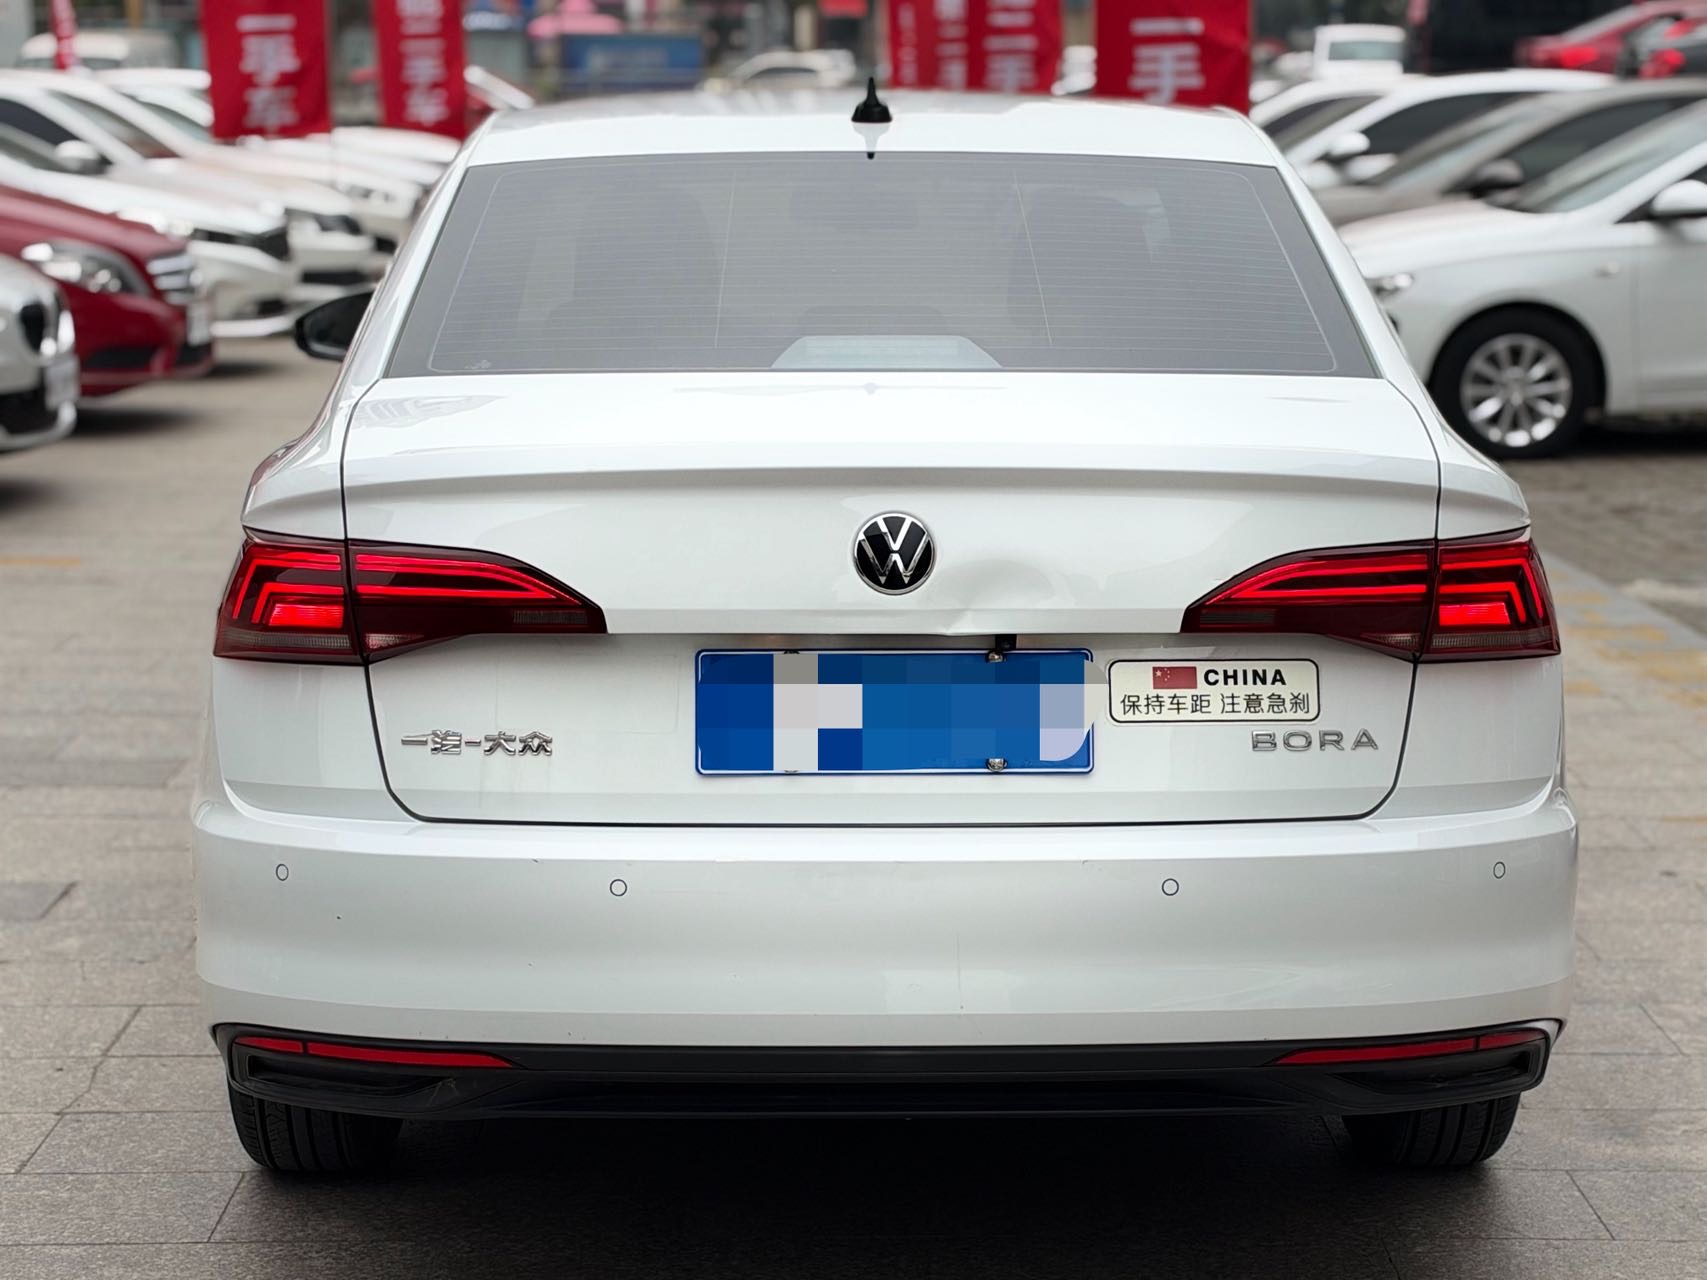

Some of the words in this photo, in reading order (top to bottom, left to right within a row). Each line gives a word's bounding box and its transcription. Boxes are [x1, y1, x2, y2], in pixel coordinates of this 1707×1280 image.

[1203, 668, 1288, 687] CHINA
[1120, 693, 1212, 716] 保持车距
[1220, 692, 1311, 716] 注意急刹
[1251, 728, 1379, 752] BORA
